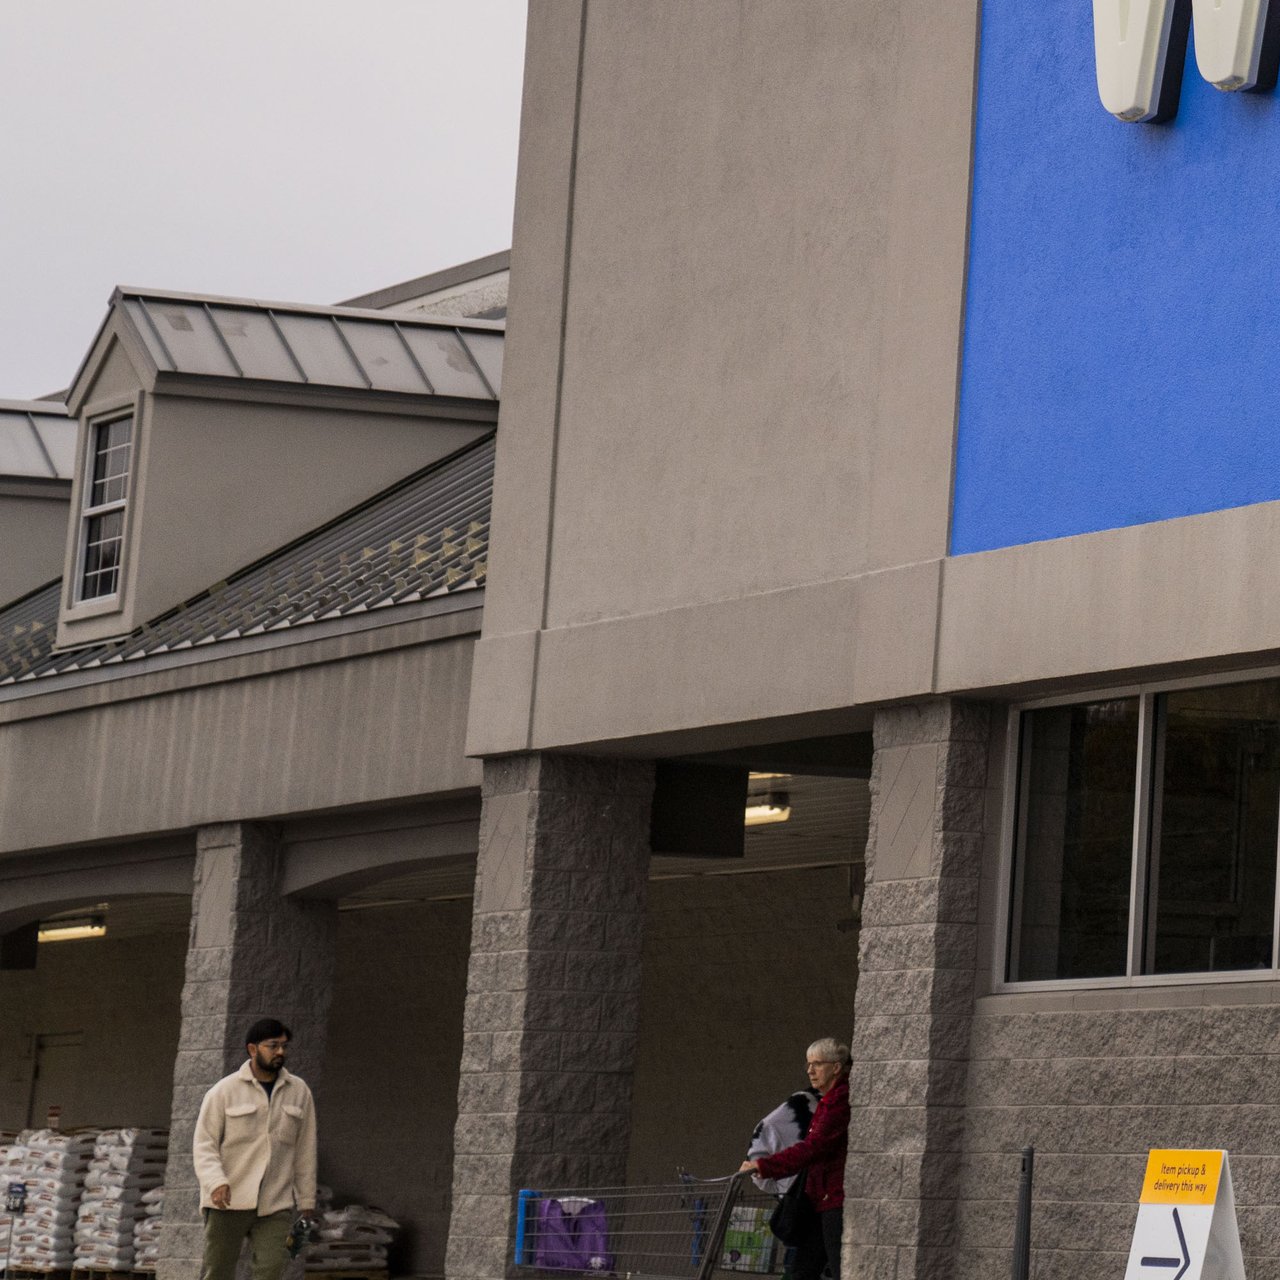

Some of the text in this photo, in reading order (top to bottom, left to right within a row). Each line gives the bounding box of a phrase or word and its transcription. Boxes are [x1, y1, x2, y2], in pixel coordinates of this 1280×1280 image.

[1161, 1163, 1206, 1179] Item pickup &
[1154, 1180, 1207, 1194] delivery this way
